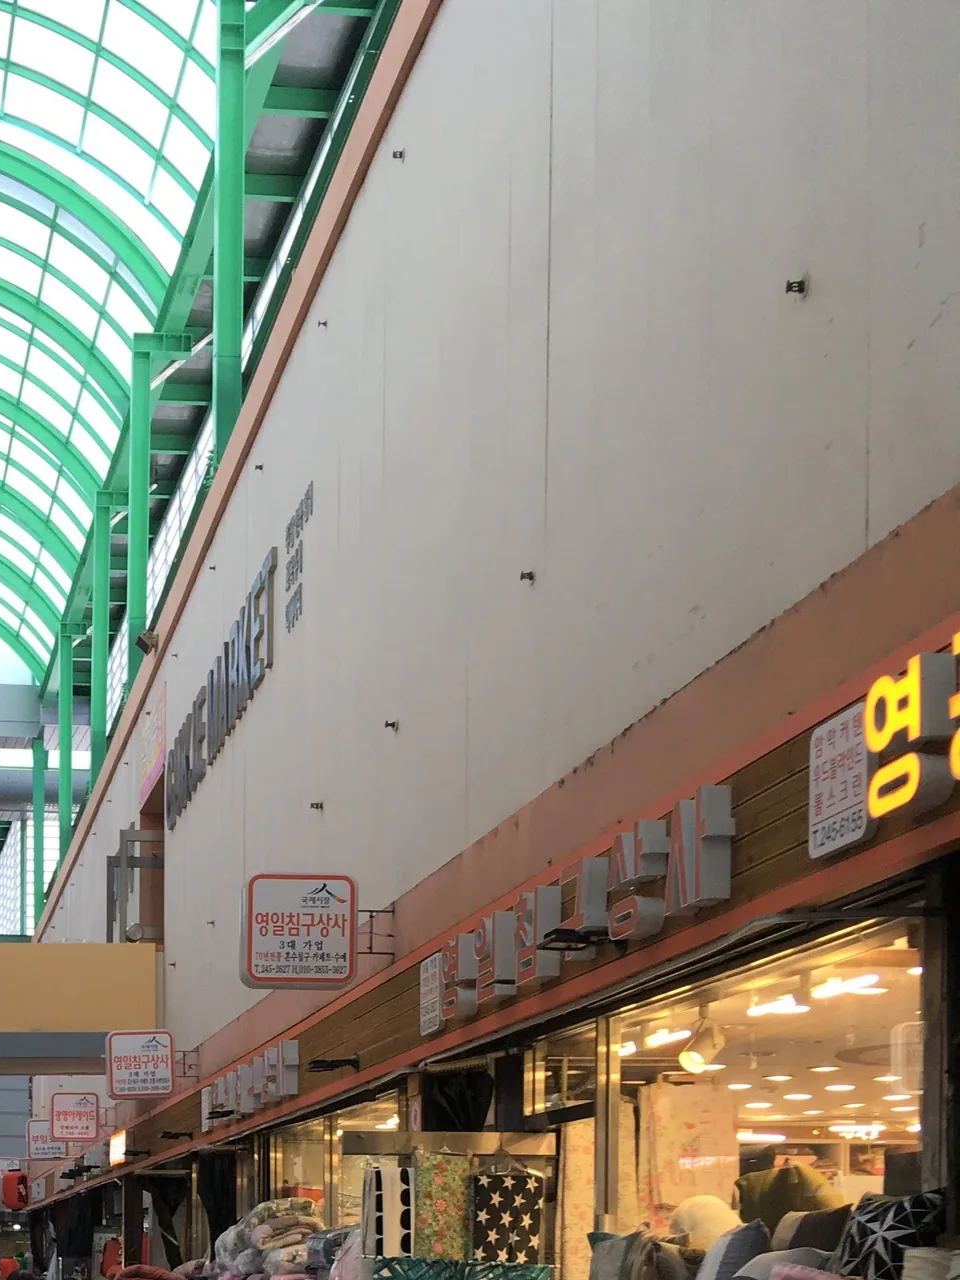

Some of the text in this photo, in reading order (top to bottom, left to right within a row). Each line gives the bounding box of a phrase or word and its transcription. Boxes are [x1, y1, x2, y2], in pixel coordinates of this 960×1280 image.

[207, 547, 278, 766] MARKET
[301, 896, 330, 904] 국제시장
[255, 912, 348, 937] 영일침구상사
[279, 940, 324, 951] 3대 가업
[113, 1055, 169, 1070] 영일침구상사
